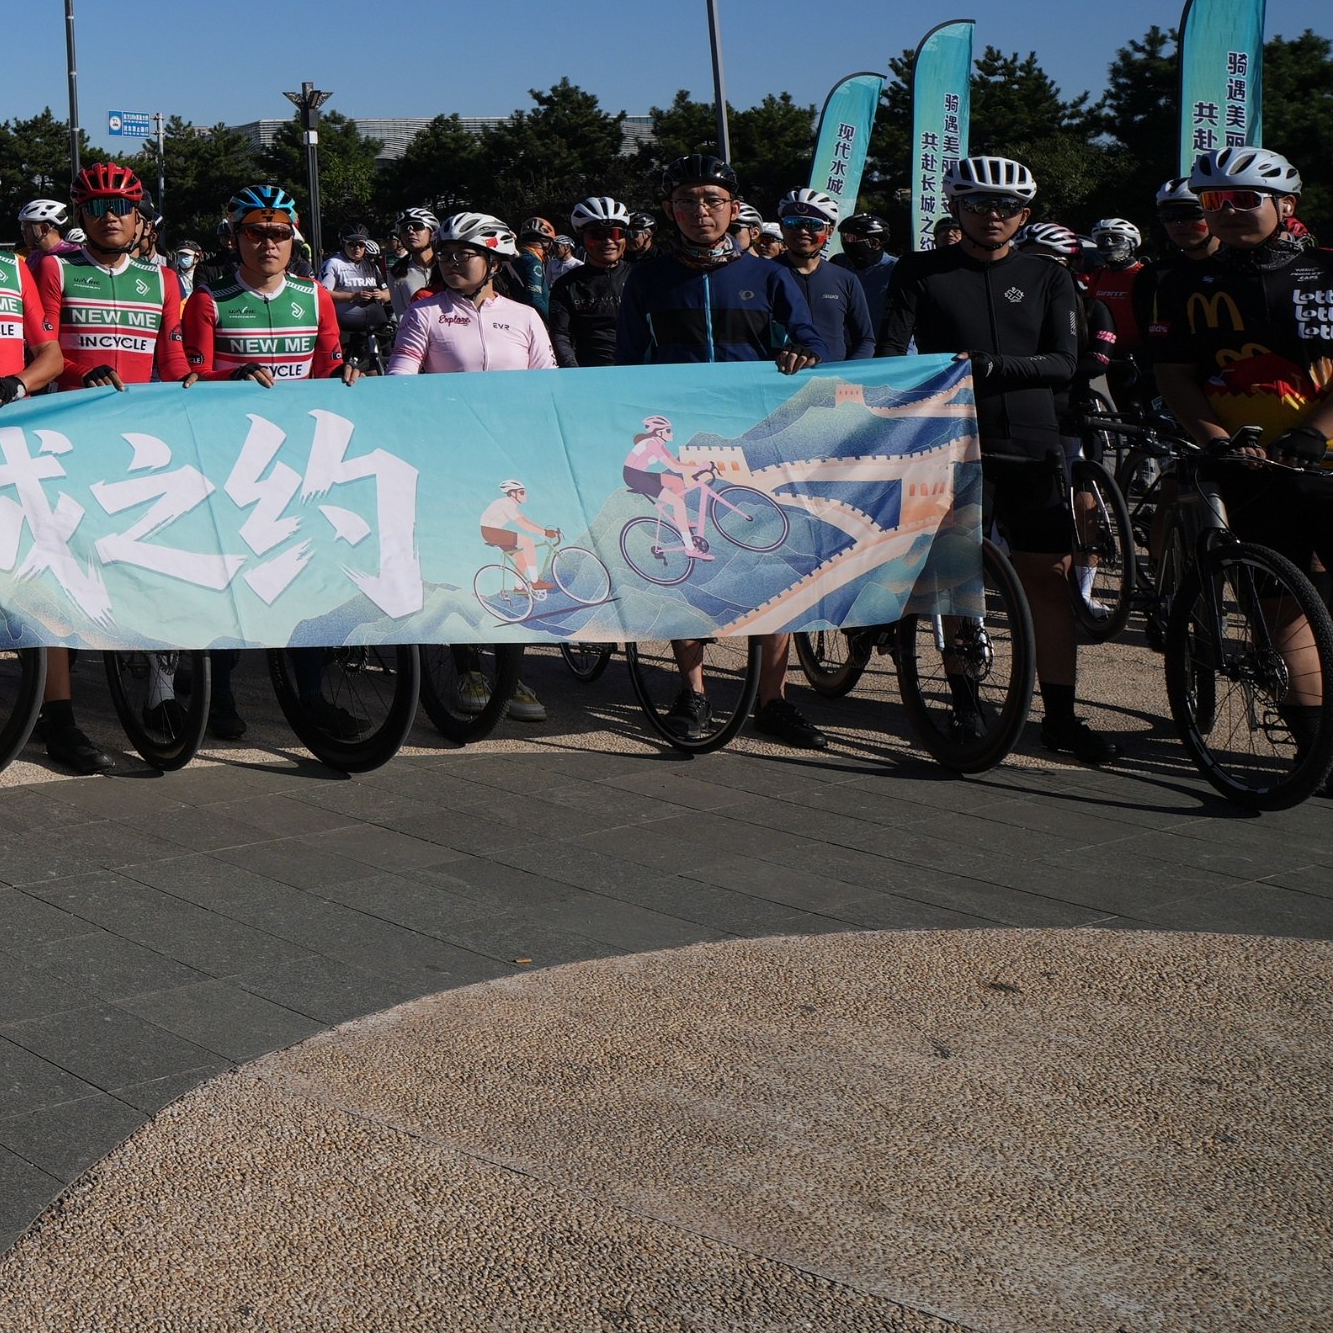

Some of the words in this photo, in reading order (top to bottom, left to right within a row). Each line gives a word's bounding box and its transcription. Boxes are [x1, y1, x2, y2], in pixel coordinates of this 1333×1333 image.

[1224, 51, 1248, 148] 骑遇美丽
[1192, 101, 1219, 164] 共赴
[826, 122, 855, 195] 现代水城
[941, 93, 960, 216] 骑遇美丽
[920, 132, 939, 251] 共赴长城之约
[1292, 289, 1333, 305] Lott
[71, 309, 120, 323] NEW
[129, 313, 157, 328] ME
[438, 314, 471, 326] Explore
[1295, 305, 1333, 322] Lot
[1297, 322, 1333, 340] Lot
[80, 336, 148, 351] INCYCLE
[230, 338, 278, 353] NEW
[285, 338, 310, 352] ME
[267, 364, 303, 378] YCLE
